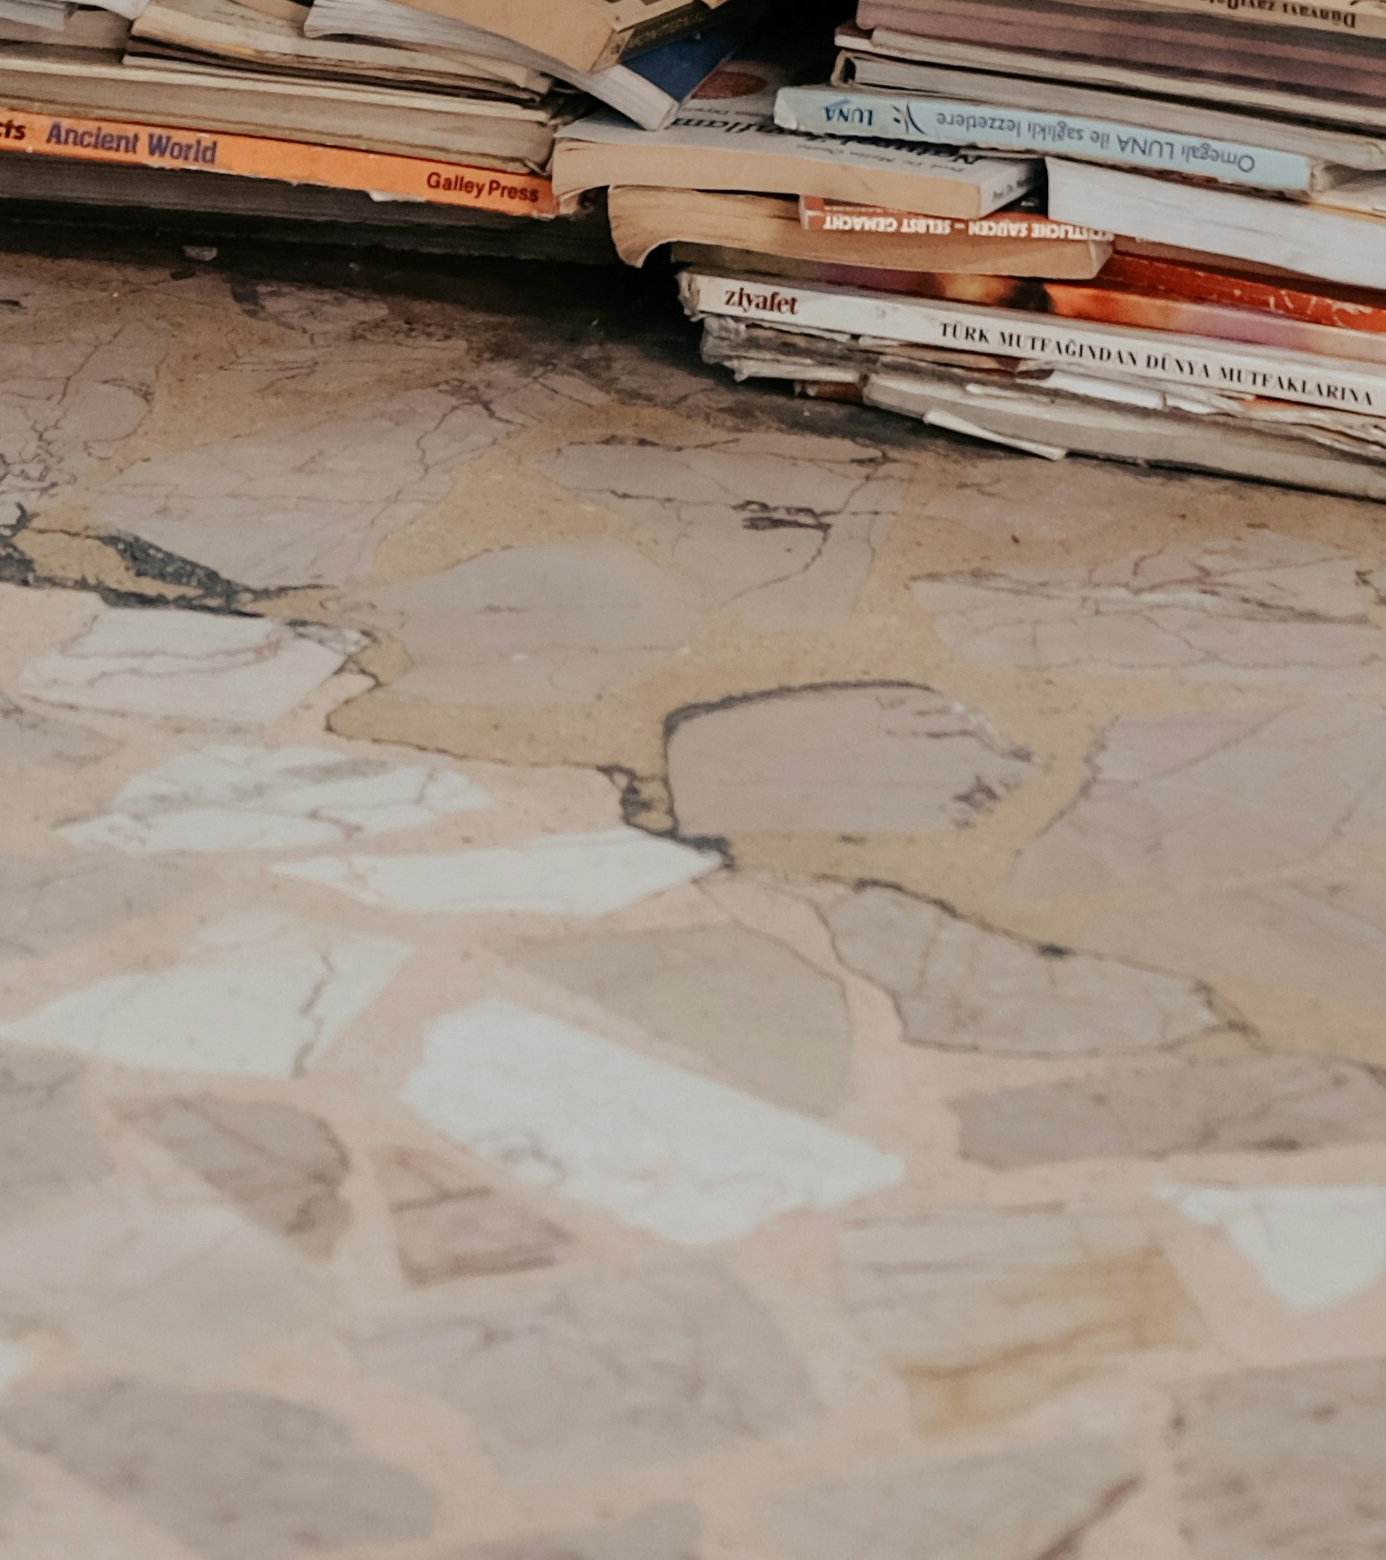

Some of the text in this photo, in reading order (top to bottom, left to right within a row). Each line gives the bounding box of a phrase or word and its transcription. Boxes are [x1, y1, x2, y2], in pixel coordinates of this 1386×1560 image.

[46, 120, 140, 154] Ancient
[147, 131, 219, 166] World
[935, 111, 1256, 174] Omegalı LUNA ile sağlıklı lezzetlere
[425, 170, 540, 205] Galley Press
[723, 285, 801, 319] ziyafet
[939, 319, 1374, 409] TÜRK MUTFAĞINDAN DÜNYA MUTFAKLARINA
